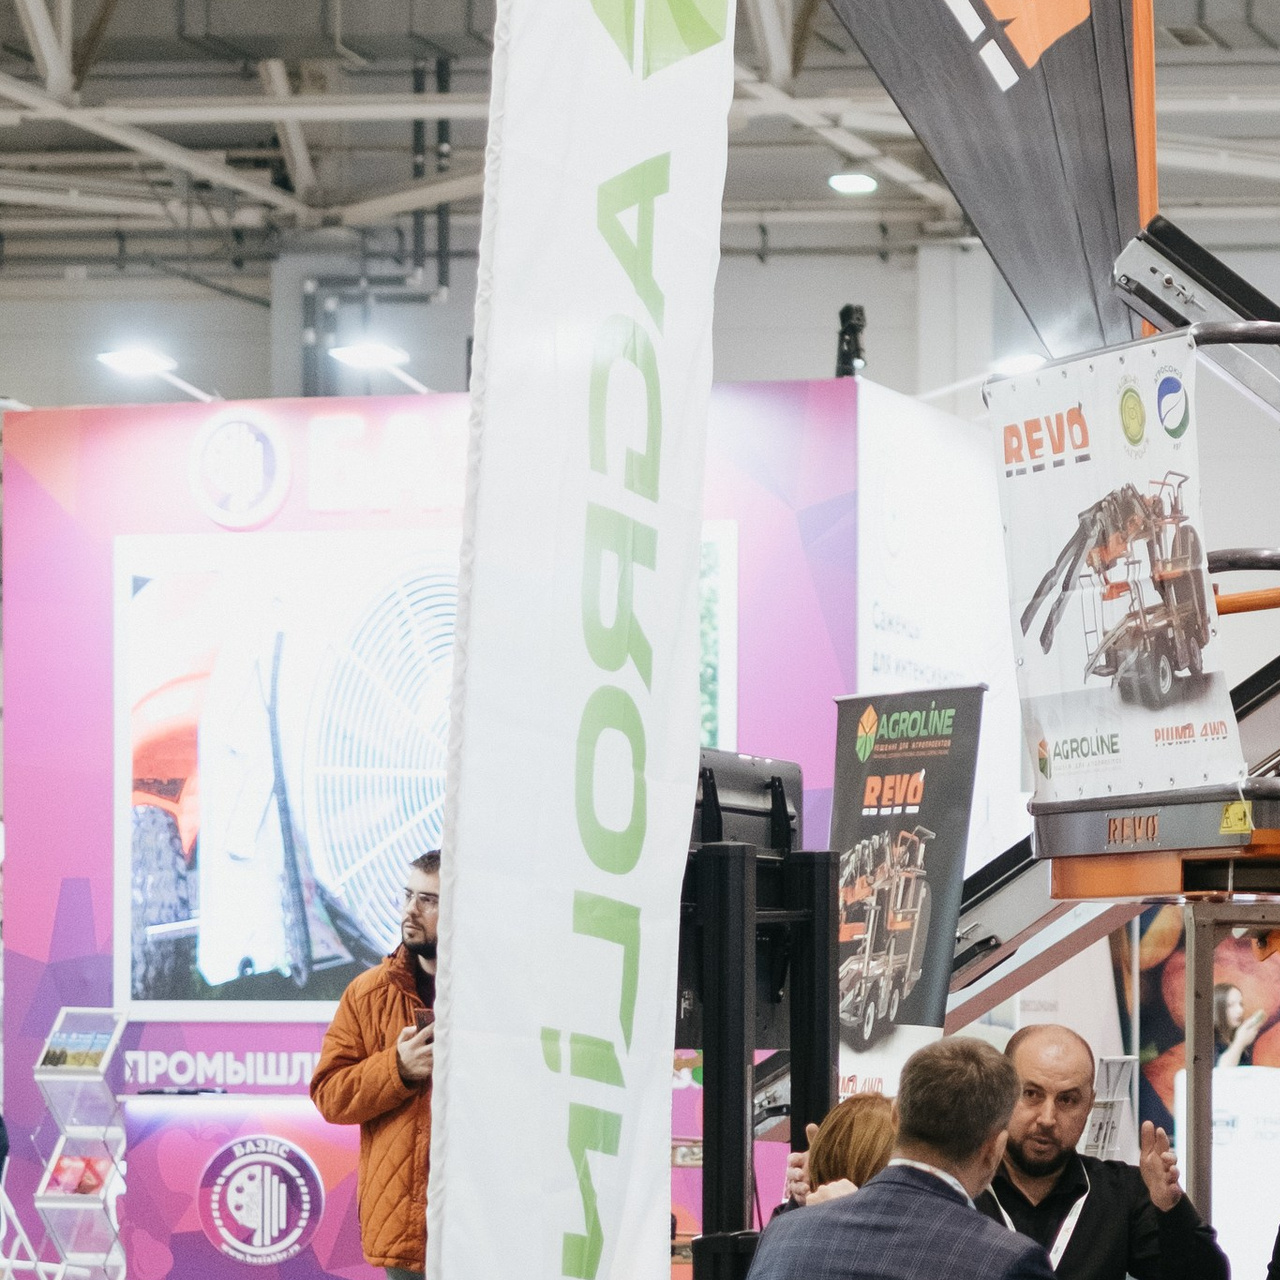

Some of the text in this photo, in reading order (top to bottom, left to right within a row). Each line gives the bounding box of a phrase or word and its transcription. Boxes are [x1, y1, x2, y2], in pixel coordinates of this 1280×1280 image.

[1003, 403, 1091, 477] REVO
[876, 701, 956, 740] AGROLINE
[1200, 720, 1228, 742] 4WD
[1053, 729, 1120, 760] AGROLINE
[862, 768, 925, 816] REVO
[1108, 813, 1159, 844] REVO
